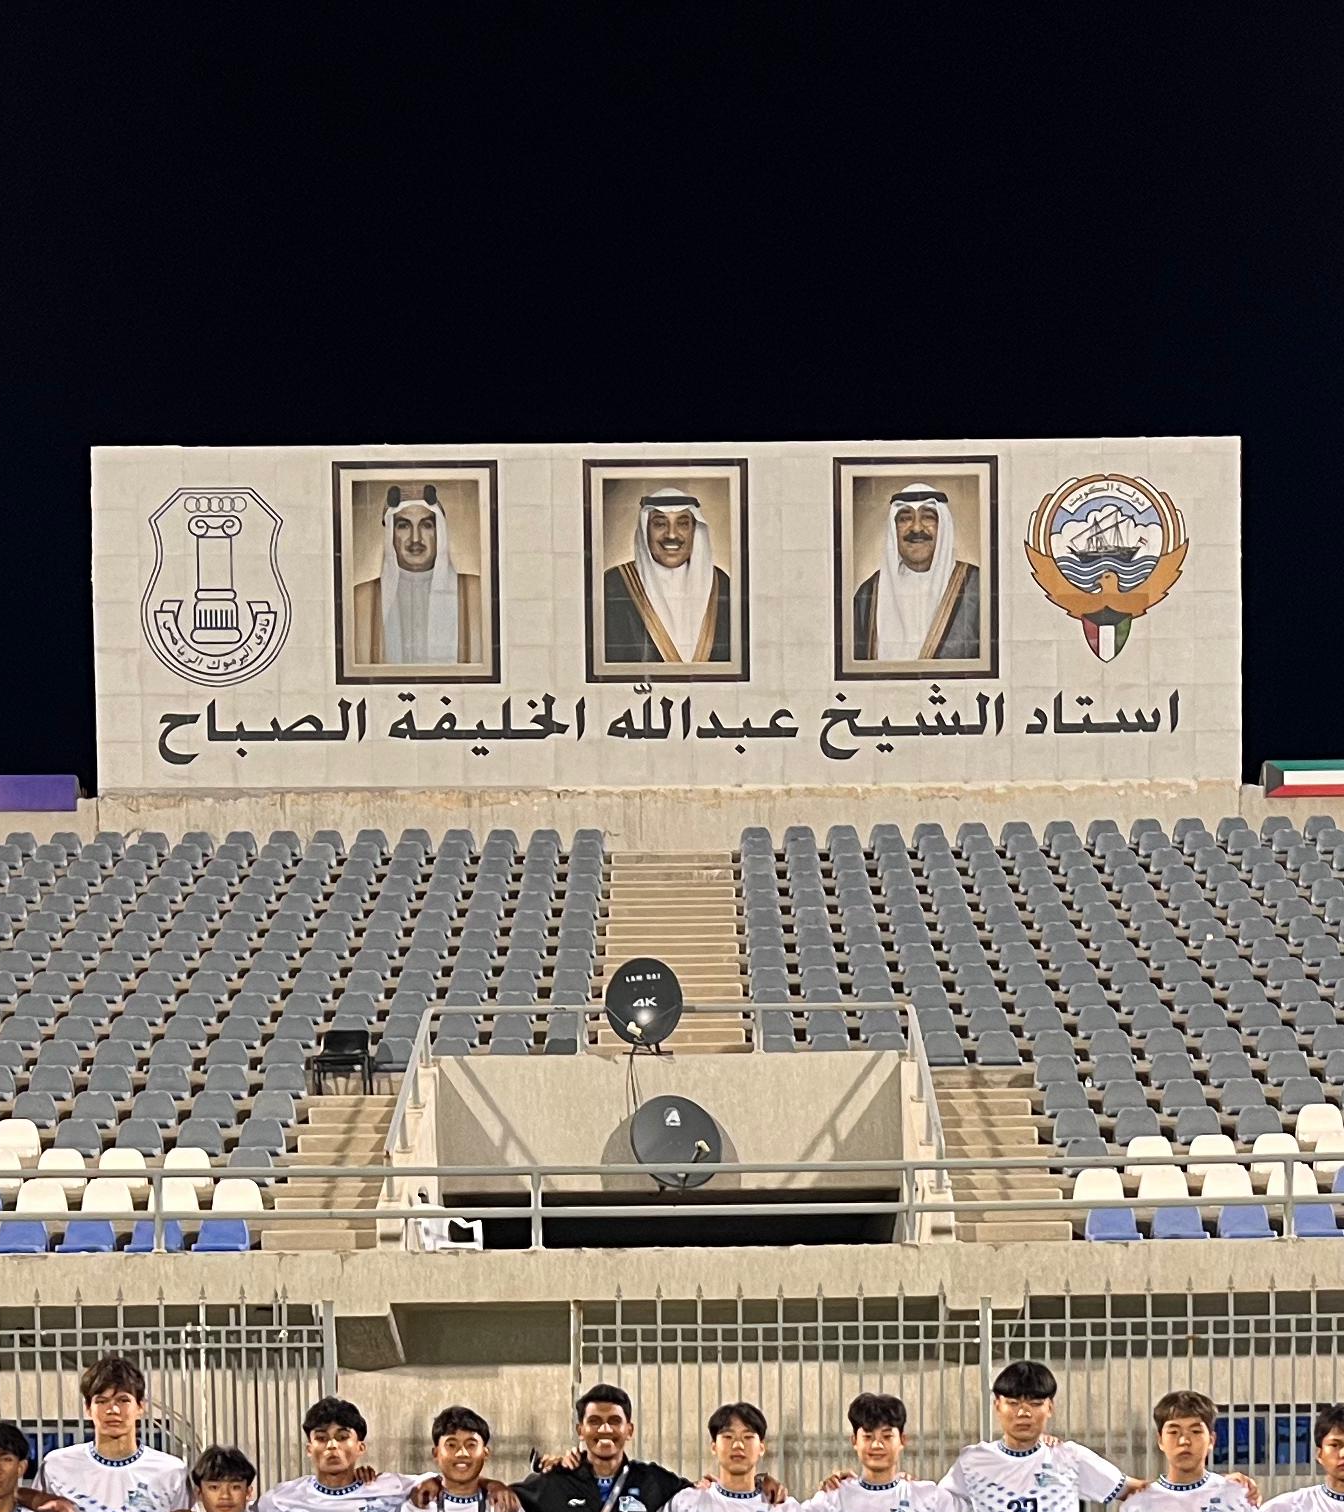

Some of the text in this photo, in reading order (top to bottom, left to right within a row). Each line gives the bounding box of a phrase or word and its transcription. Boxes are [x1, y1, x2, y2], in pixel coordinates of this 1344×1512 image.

[158, 697, 367, 765] الصباح
[388, 691, 586, 757] الخليفة
[819, 683, 1005, 760] الشيخ
[1025, 689, 1180, 735] استاد
[632, 997, 658, 1007] 4K
